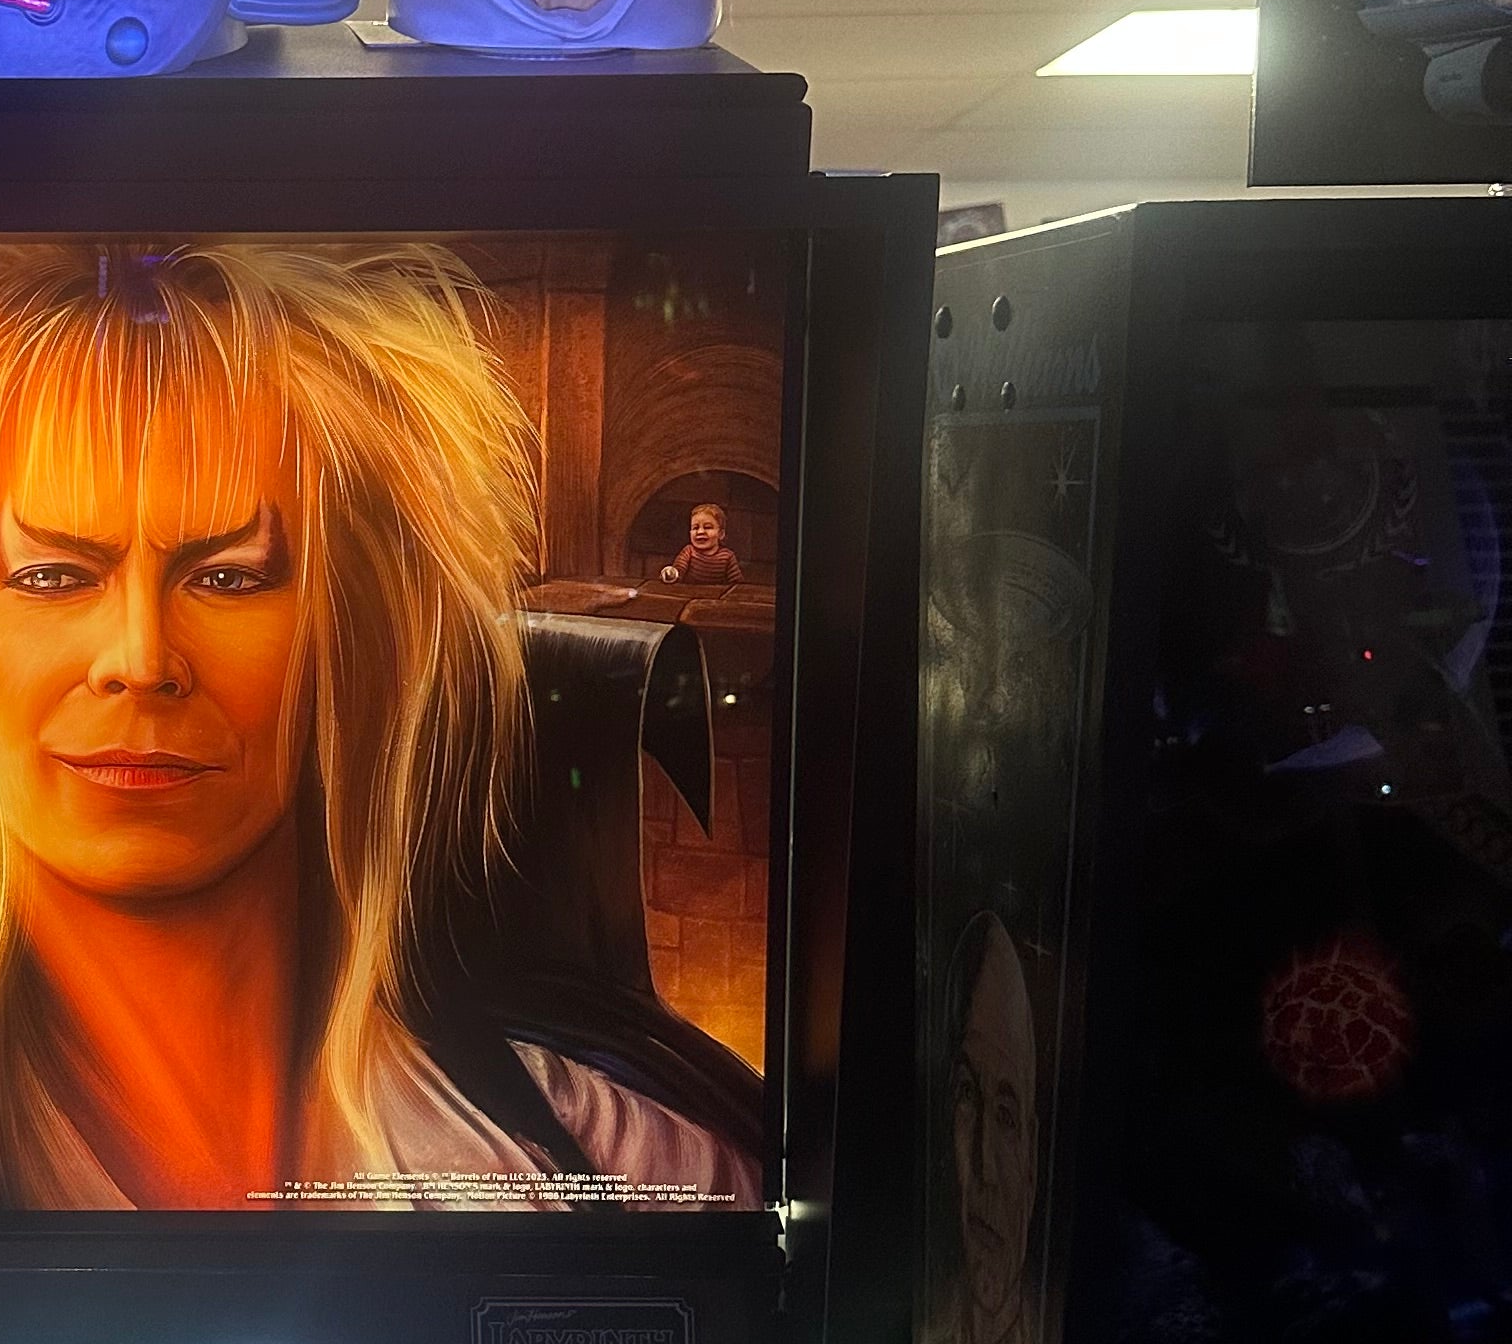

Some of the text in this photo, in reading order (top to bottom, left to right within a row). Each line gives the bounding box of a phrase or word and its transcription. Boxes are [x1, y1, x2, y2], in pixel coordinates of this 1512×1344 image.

[509, 1173, 524, 1181] LLC
[313, 1182, 327, 1190] The
[682, 1184, 697, 1192] and
